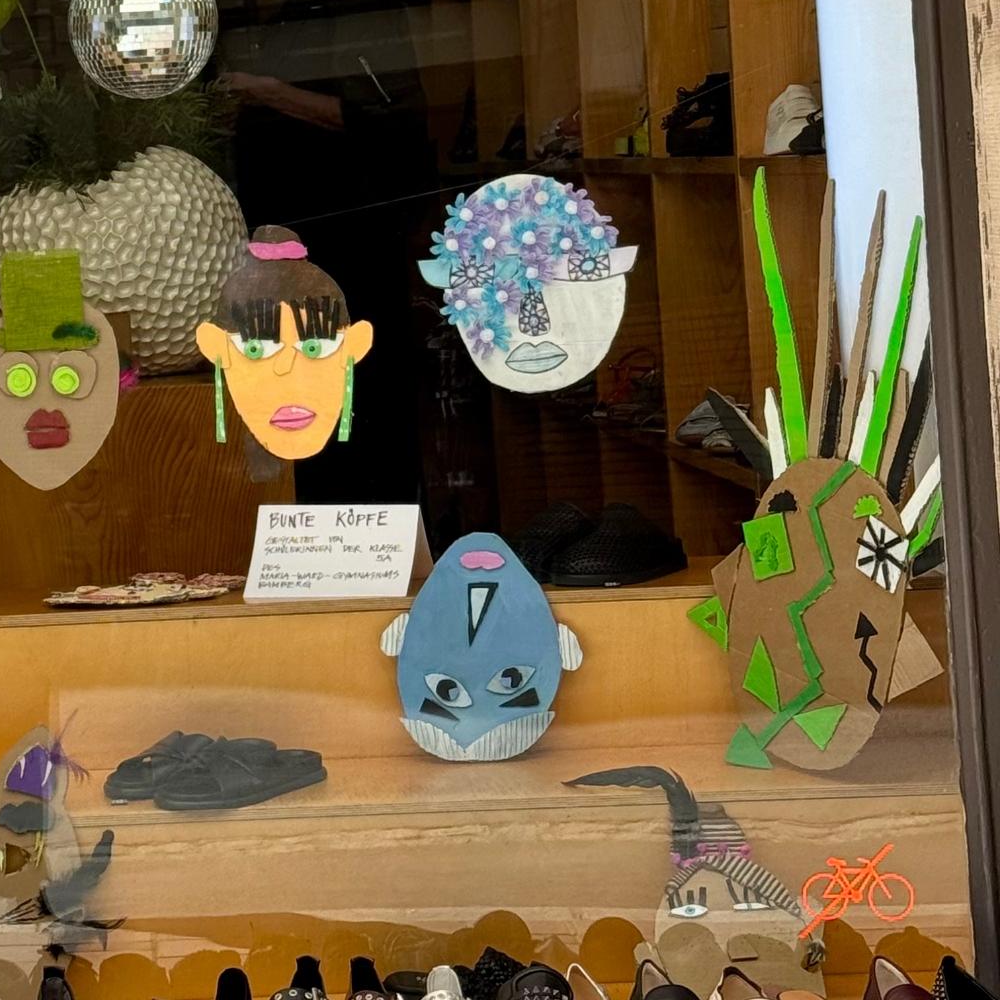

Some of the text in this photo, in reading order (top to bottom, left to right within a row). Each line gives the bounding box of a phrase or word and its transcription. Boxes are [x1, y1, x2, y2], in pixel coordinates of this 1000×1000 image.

[269, 508, 388, 529] BUNTE KÖPFE
[343, 545, 362, 553] DER
[369, 544, 402, 553] KLASSE
